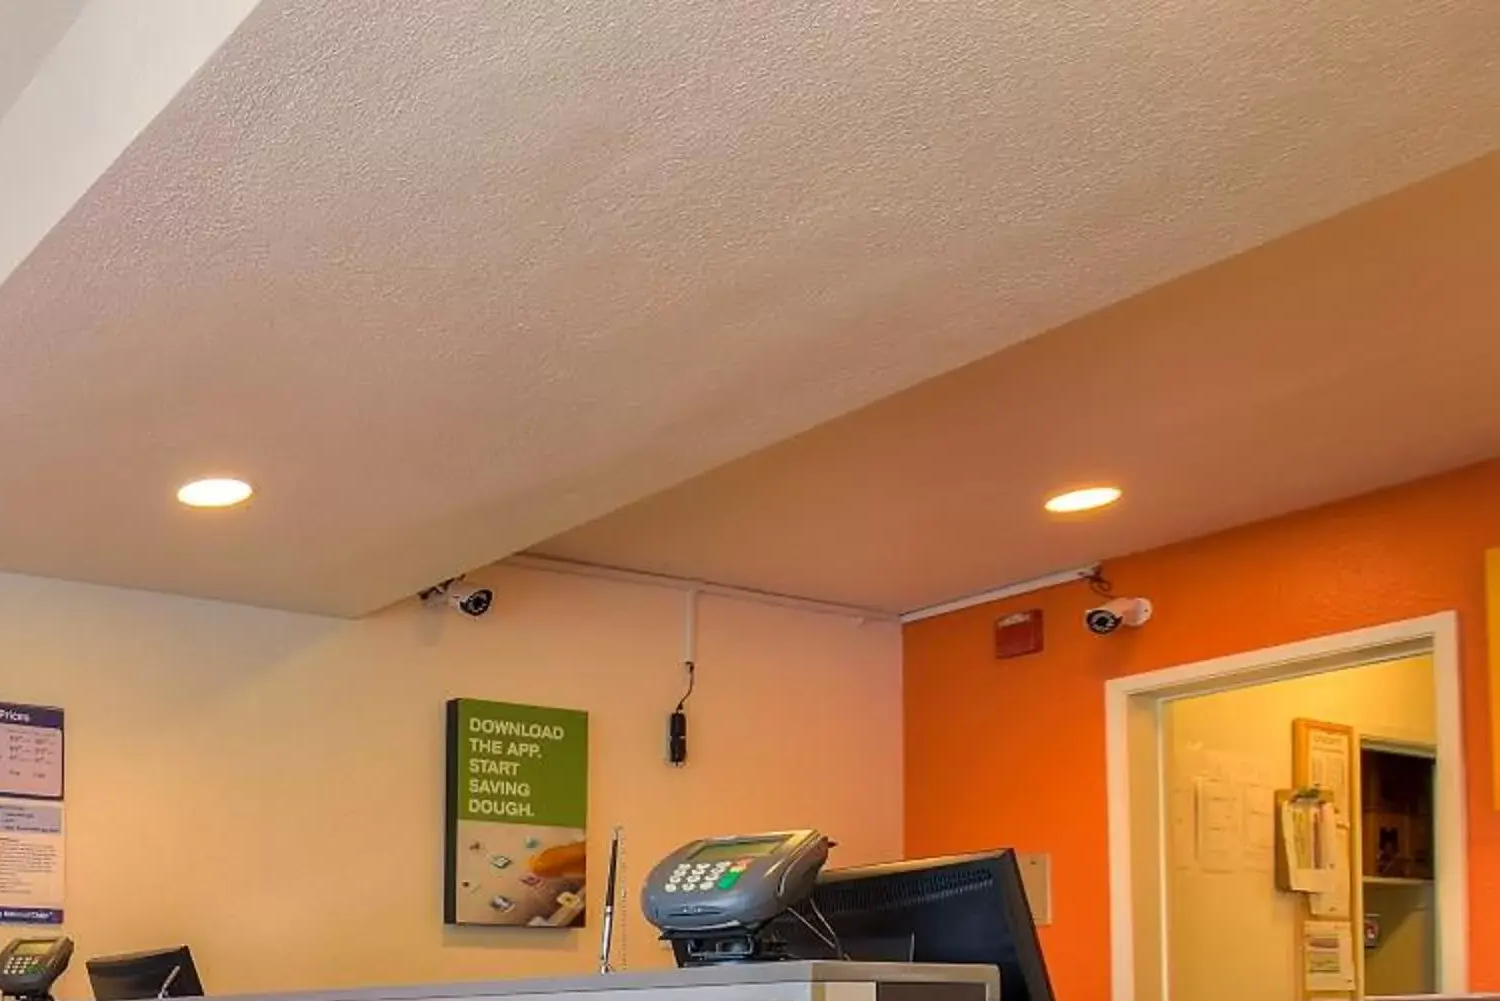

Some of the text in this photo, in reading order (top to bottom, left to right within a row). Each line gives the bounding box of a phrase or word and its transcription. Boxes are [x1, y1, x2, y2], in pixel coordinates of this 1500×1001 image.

[469, 717, 565, 740] DOWNLOAD
[469, 738, 542, 759] THE APP.
[469, 758, 520, 776] START
[469, 779, 531, 797] SAVING
[468, 798, 535, 817] DOUGH.
